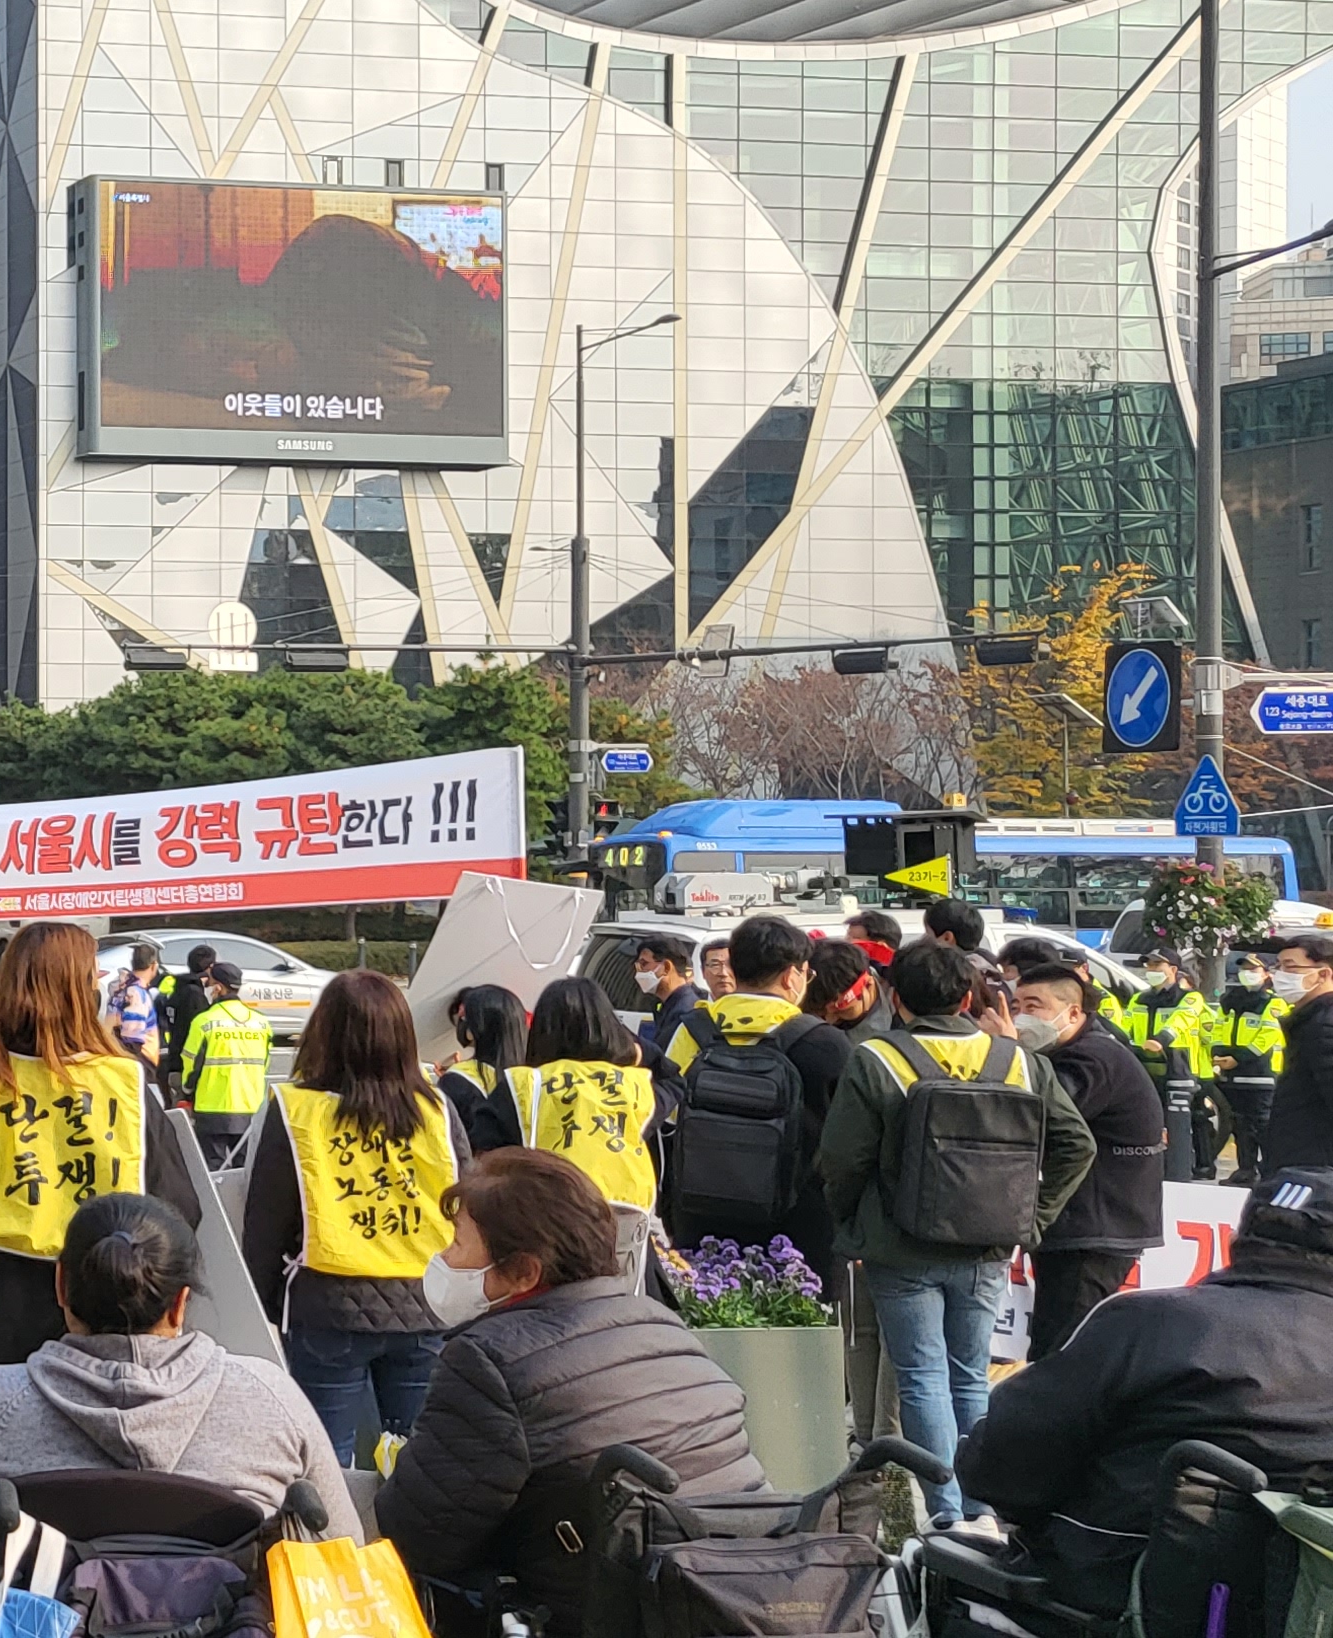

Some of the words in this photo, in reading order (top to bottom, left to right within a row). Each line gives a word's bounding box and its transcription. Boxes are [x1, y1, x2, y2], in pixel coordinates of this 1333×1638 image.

[224, 392, 302, 418] 이웃들이
[306, 394, 384, 420] 있습니다
[276, 439, 333, 451] SAMSUNG
[1265, 706, 1280, 717] 123
[1285, 694, 1329, 708] 세종대로
[153, 800, 241, 868] 강력
[253, 791, 413, 860] 규탄한다
[429, 778, 479, 844] !!!
[1184, 821, 1227, 833] 자전거횡단
[604, 845, 645, 868] 402
[908, 870, 947, 882] 23기-2
[24, 882, 244, 912] 서울시장애인자립생활센터총연합회
[251, 987, 294, 1000] 서울신문
[214, 1031, 259, 1040] POLICE
[541, 1068, 640, 1107] 단결!
[4, 1151, 121, 1206] 투쟁!
[334, 1166, 421, 1202] 노동권
[348, 1204, 421, 1240] 쟁취!
